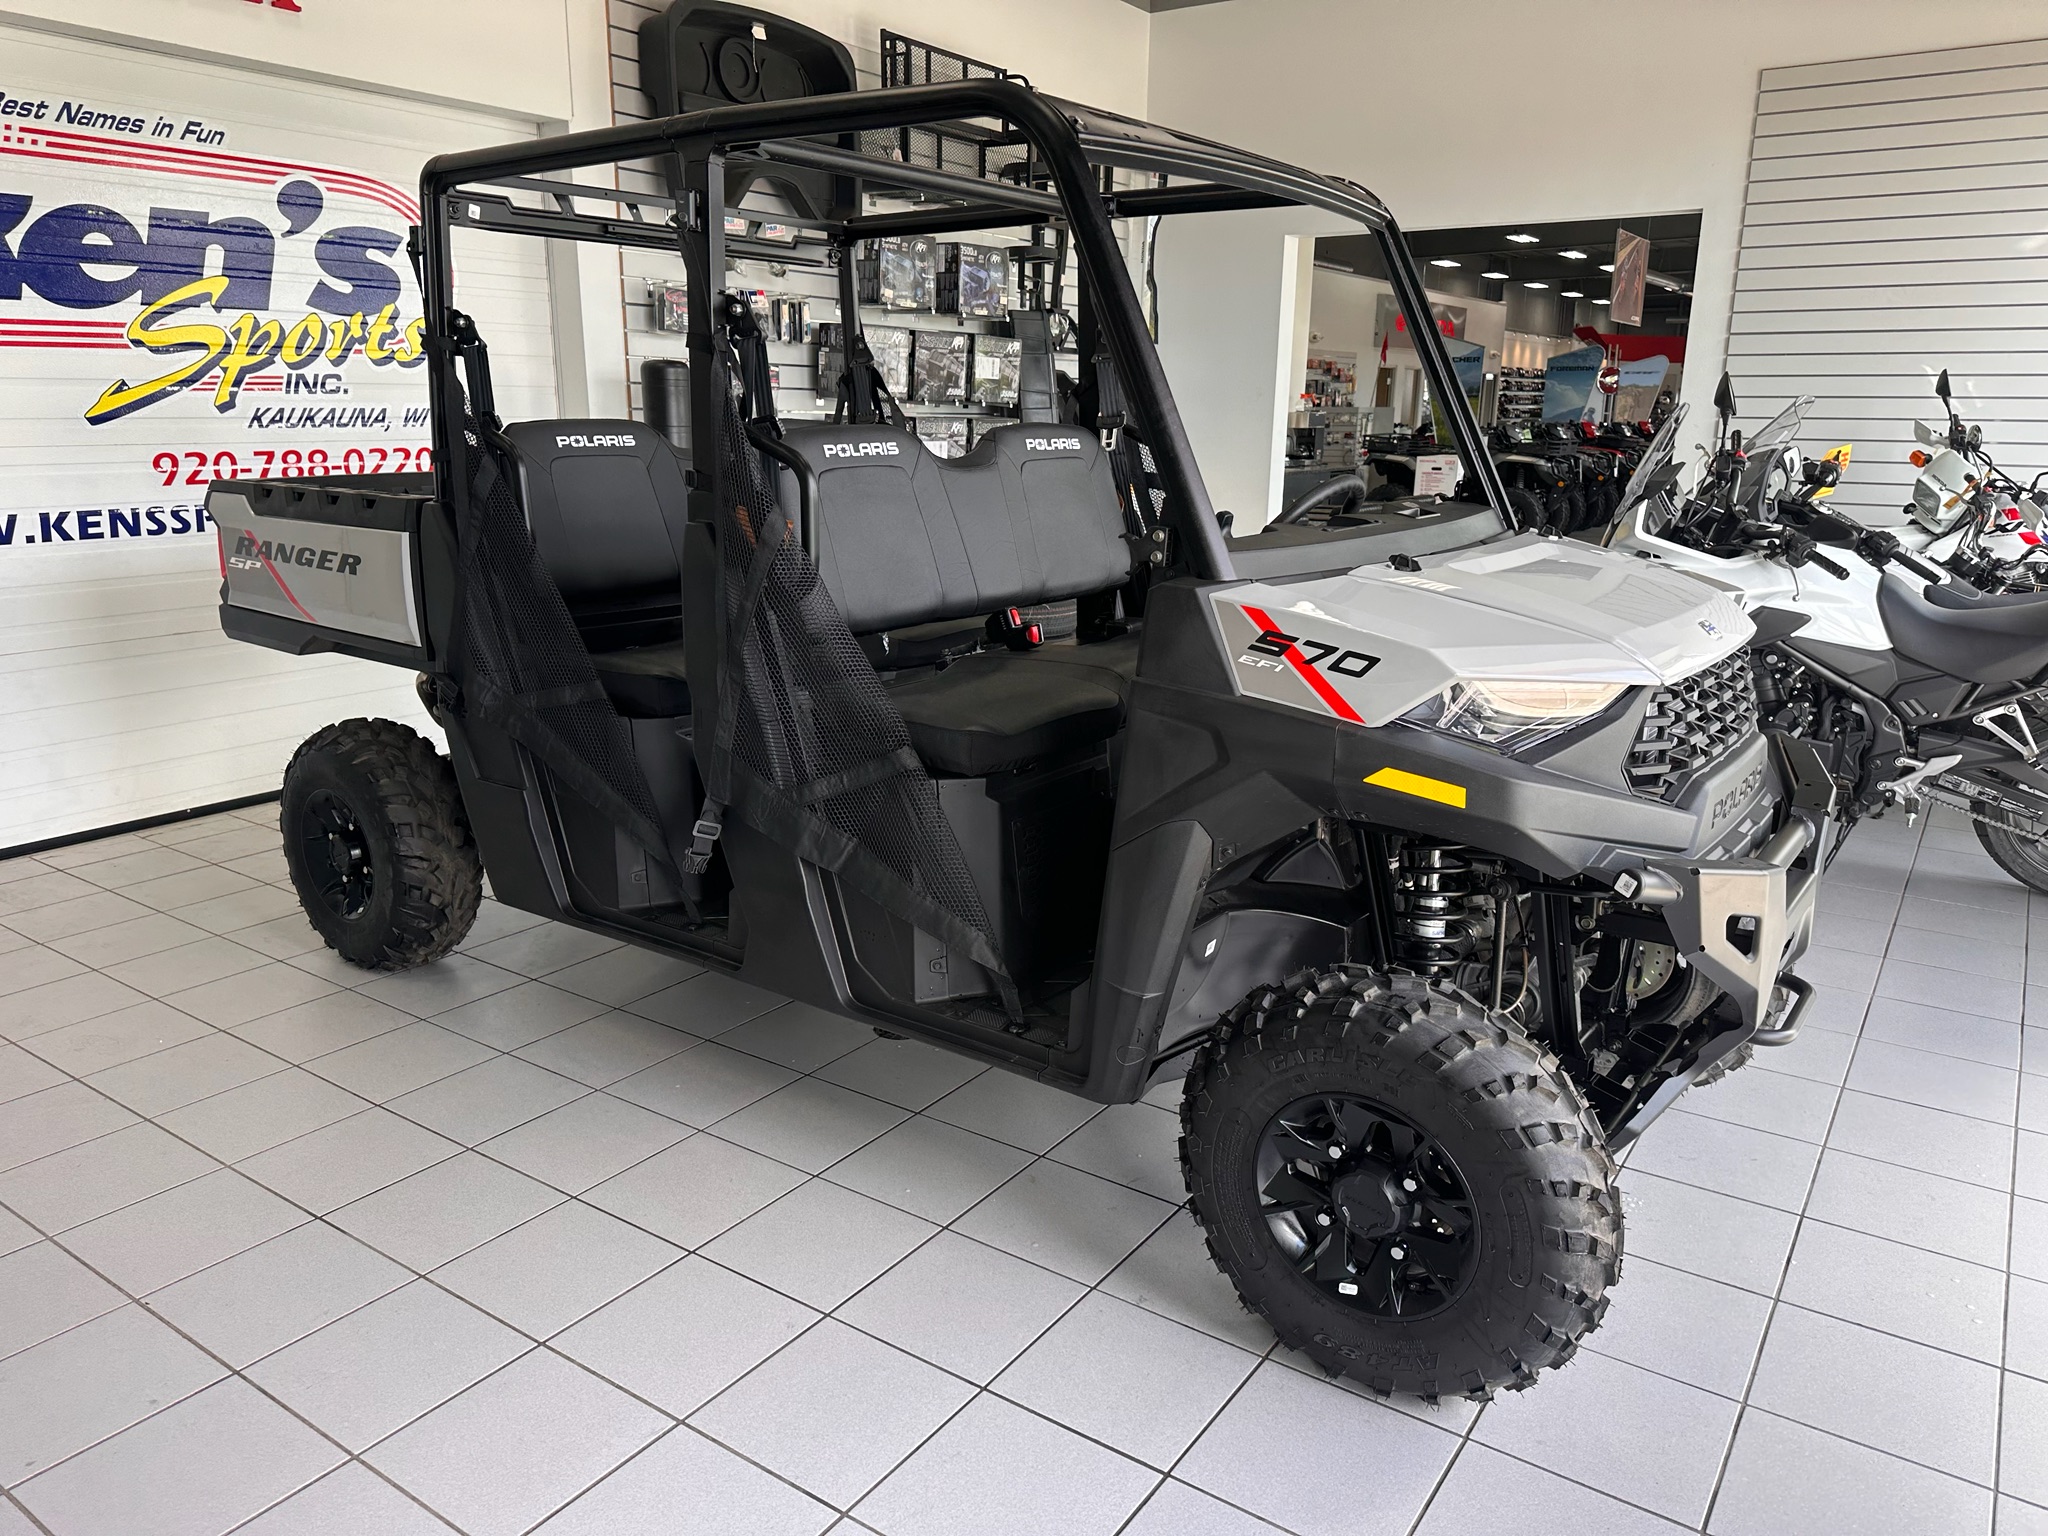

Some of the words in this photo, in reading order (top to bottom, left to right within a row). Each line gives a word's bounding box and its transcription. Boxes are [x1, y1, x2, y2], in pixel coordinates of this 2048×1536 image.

[54, 101, 145, 134] Names
[151, 116, 174, 138] in
[180, 120, 225, 146] Fun
[285, 373, 349, 395] INC.
[248, 407, 392, 432] KAUKAUNA,
[402, 407, 431, 428] WI
[555, 434, 637, 448] POLARIS
[822, 441, 900, 458] POLARIS
[1025, 437, 1081, 451] POLARIS
[152, 447, 434, 486] 920-788-0220
[228, 556, 262, 570] SP
[234, 535, 362, 576] RANGER
[1237, 654, 1285, 672] EFI
[1247, 629, 1381, 678] 570
[1711, 761, 1763, 830] POLARIS
